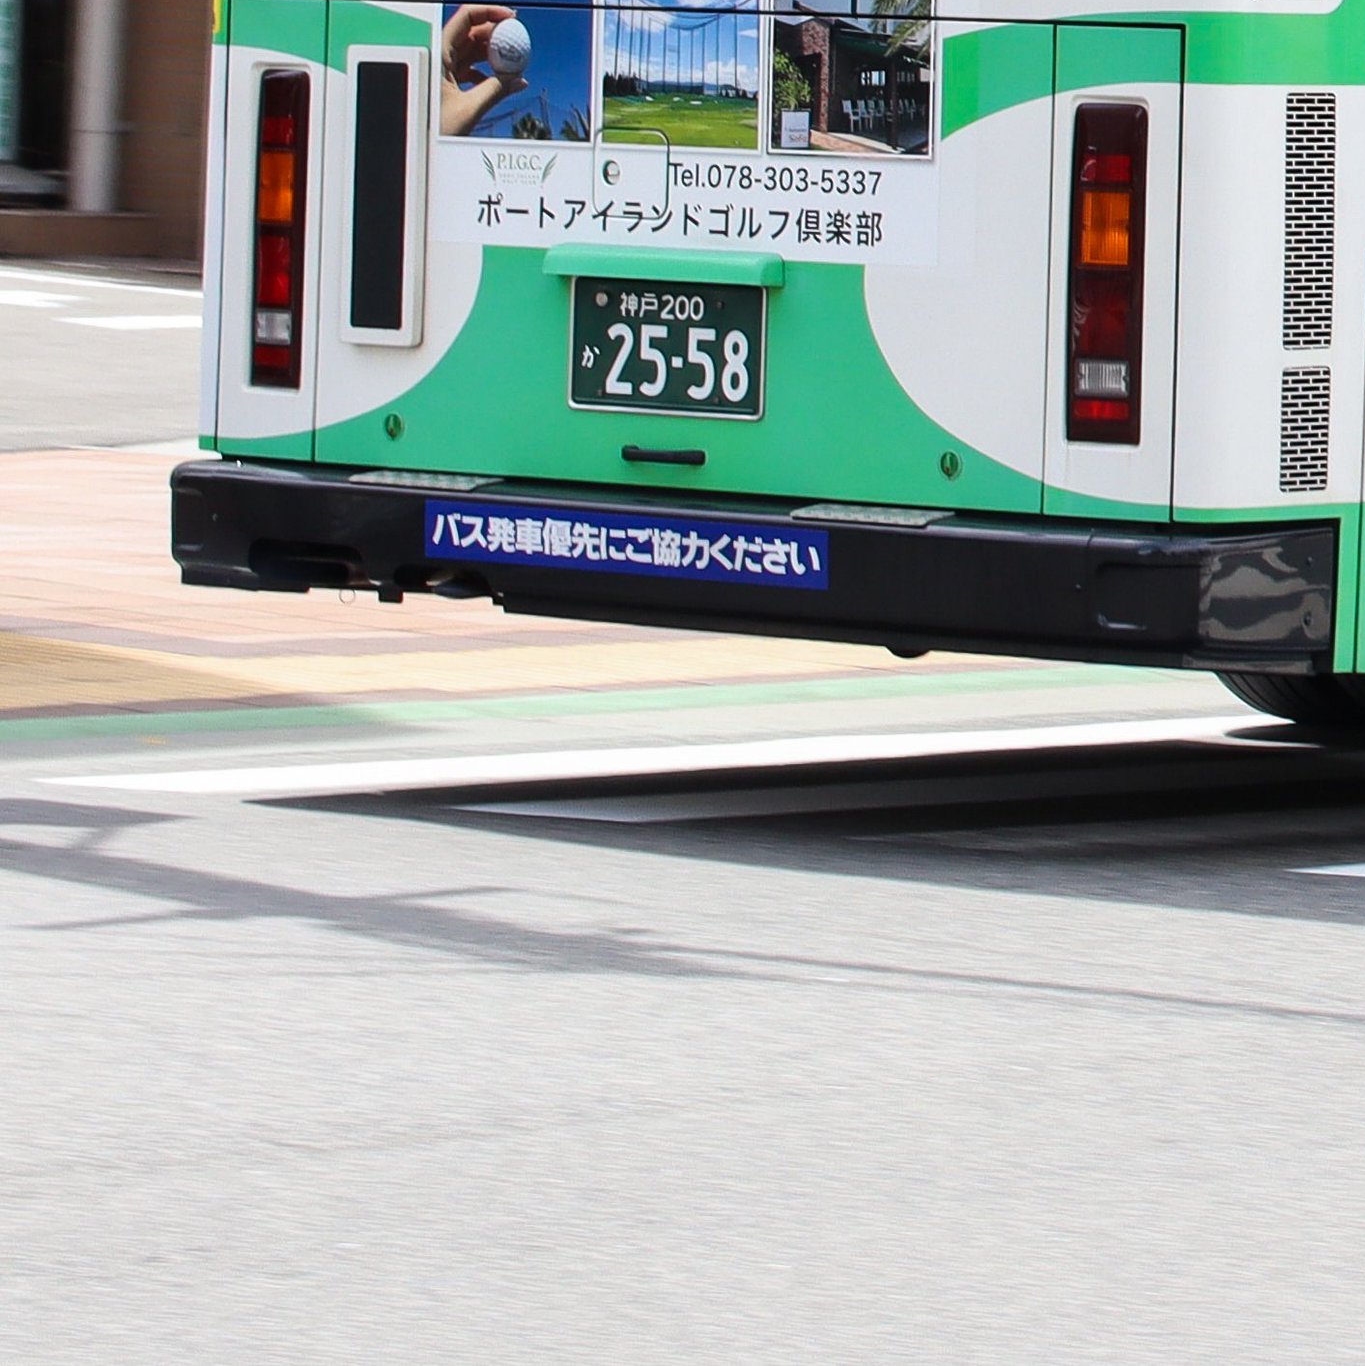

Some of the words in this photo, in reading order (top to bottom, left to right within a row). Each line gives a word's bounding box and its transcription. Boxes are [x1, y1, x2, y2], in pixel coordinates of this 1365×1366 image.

[670, 163, 882, 194] Tel.078-303-5337
[477, 192, 883, 247] ポートアイランドゴルフ倶楽部
[580, 343, 600, 369] か
[605, 322, 749, 403] 25-58
[431, 512, 821, 575] バス発車優先にご協力ください
